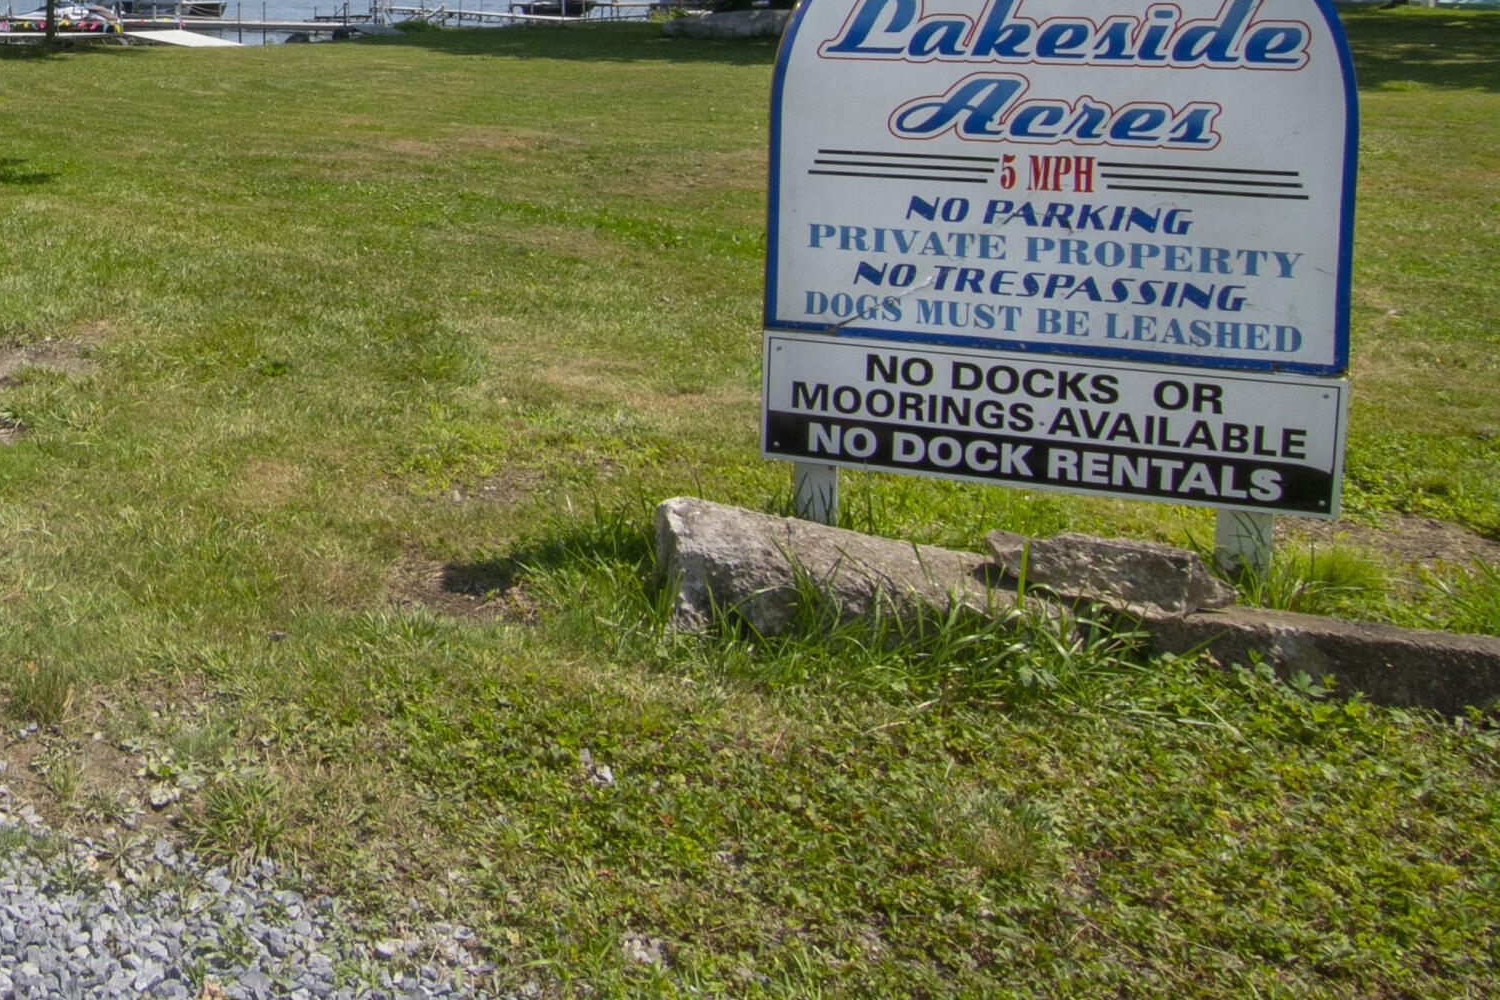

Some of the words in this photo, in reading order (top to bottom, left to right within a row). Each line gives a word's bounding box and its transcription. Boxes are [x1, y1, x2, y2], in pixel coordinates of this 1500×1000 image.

[895, 78, 1218, 145] Acres
[1000, 155, 1017, 190] 5
[1028, 156, 1094, 192] MPH
[906, 196, 969, 223] NO
[983, 201, 1193, 235] PARKING
[807, 223, 1006, 260] PRIVATE
[1025, 237, 1304, 279] PROPERTY
[854, 262, 914, 287] NO
[932, 267, 1248, 311] TRESPASSING
[805, 291, 902, 322] DOGS
[916, 304, 1022, 332] MUST
[1036, 309, 1090, 336] BE
[1106, 314, 1302, 352] LEASHED
[866, 353, 932, 386] NO
[951, 361, 1119, 404] DOCKS
[1153, 380, 1223, 414] OR
[792, 381, 1034, 432] MOORINGS
[1048, 407, 1307, 460] AVAILABLE
[807, 423, 877, 460] NO
[892, 432, 1031, 477] DOCK
[1047, 448, 1283, 501] RENTALS
